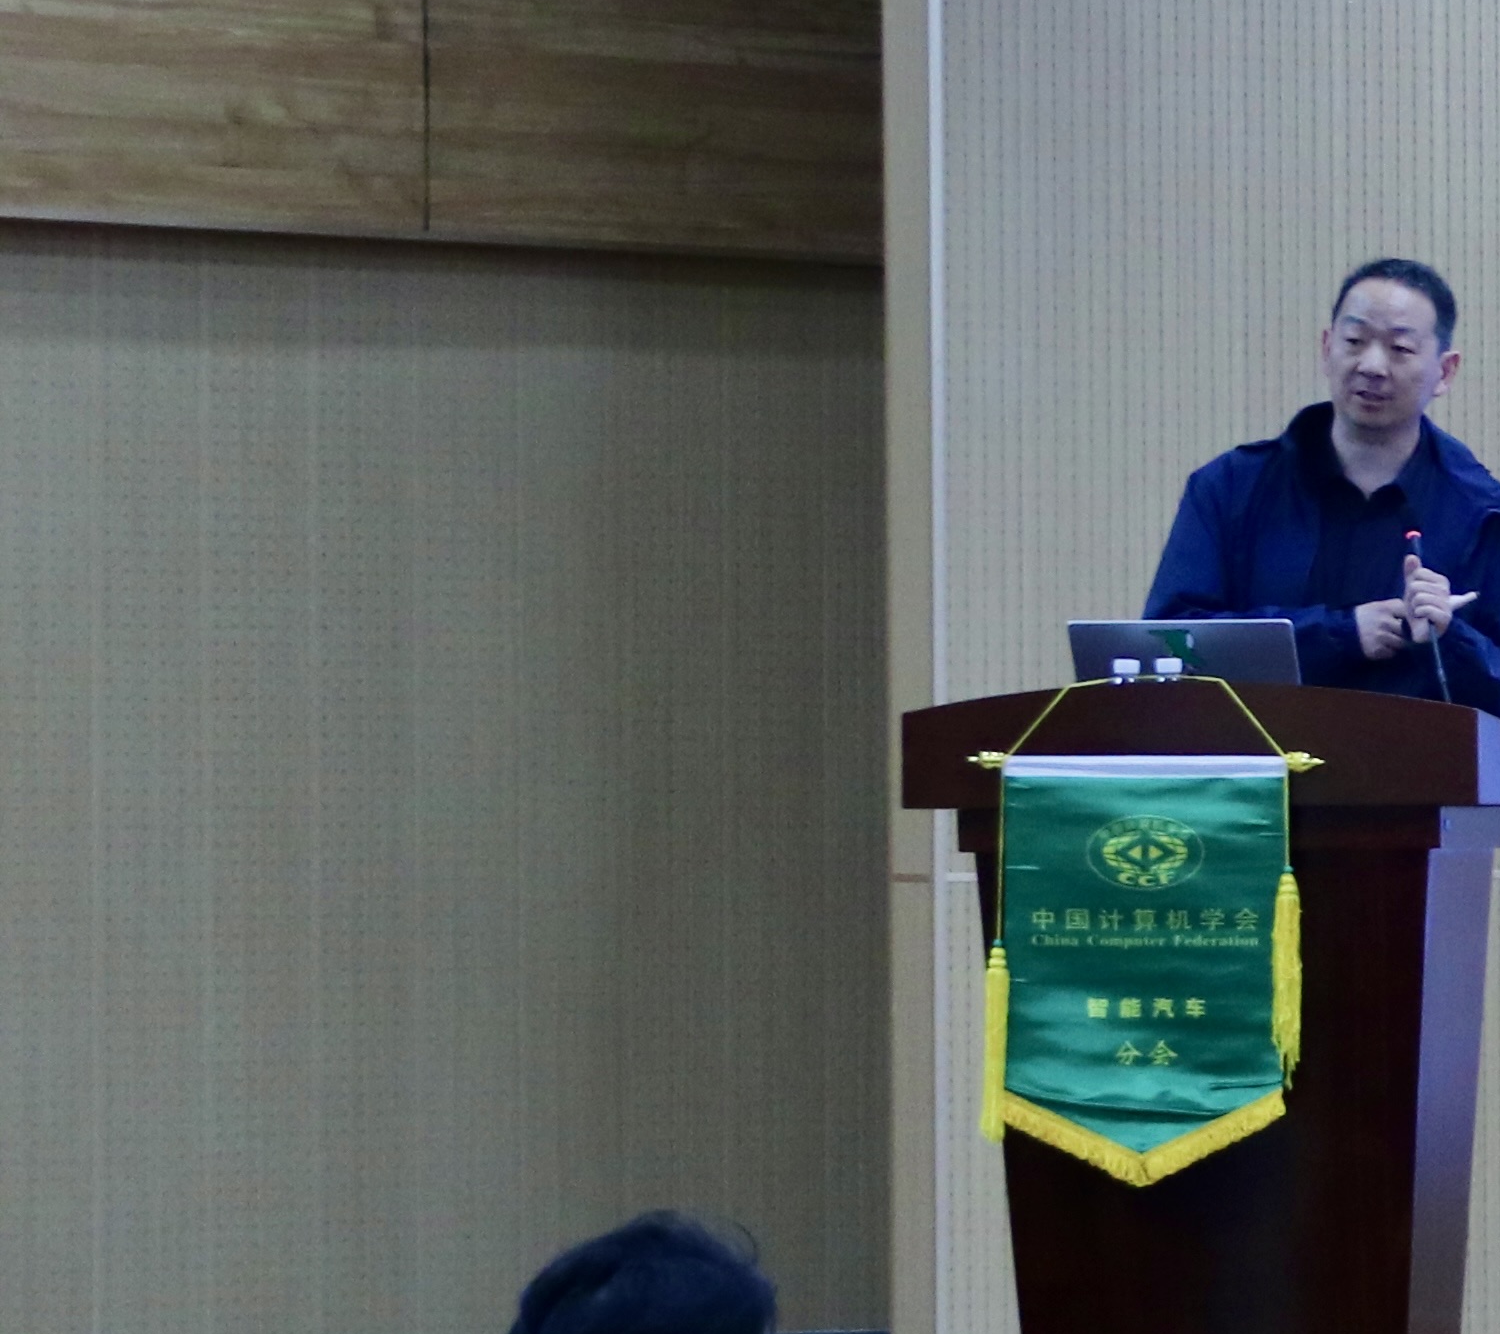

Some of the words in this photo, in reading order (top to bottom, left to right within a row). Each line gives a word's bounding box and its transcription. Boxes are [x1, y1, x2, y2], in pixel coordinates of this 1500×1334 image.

[1031, 907, 1260, 931] 中国计算机学会
[1031, 934, 1080, 947] China
[1086, 934, 1166, 949] Computer
[1172, 934, 1259, 947] Federation
[1087, 997, 1206, 1018] 智能汽车
[1115, 1040, 1178, 1065] 分会
